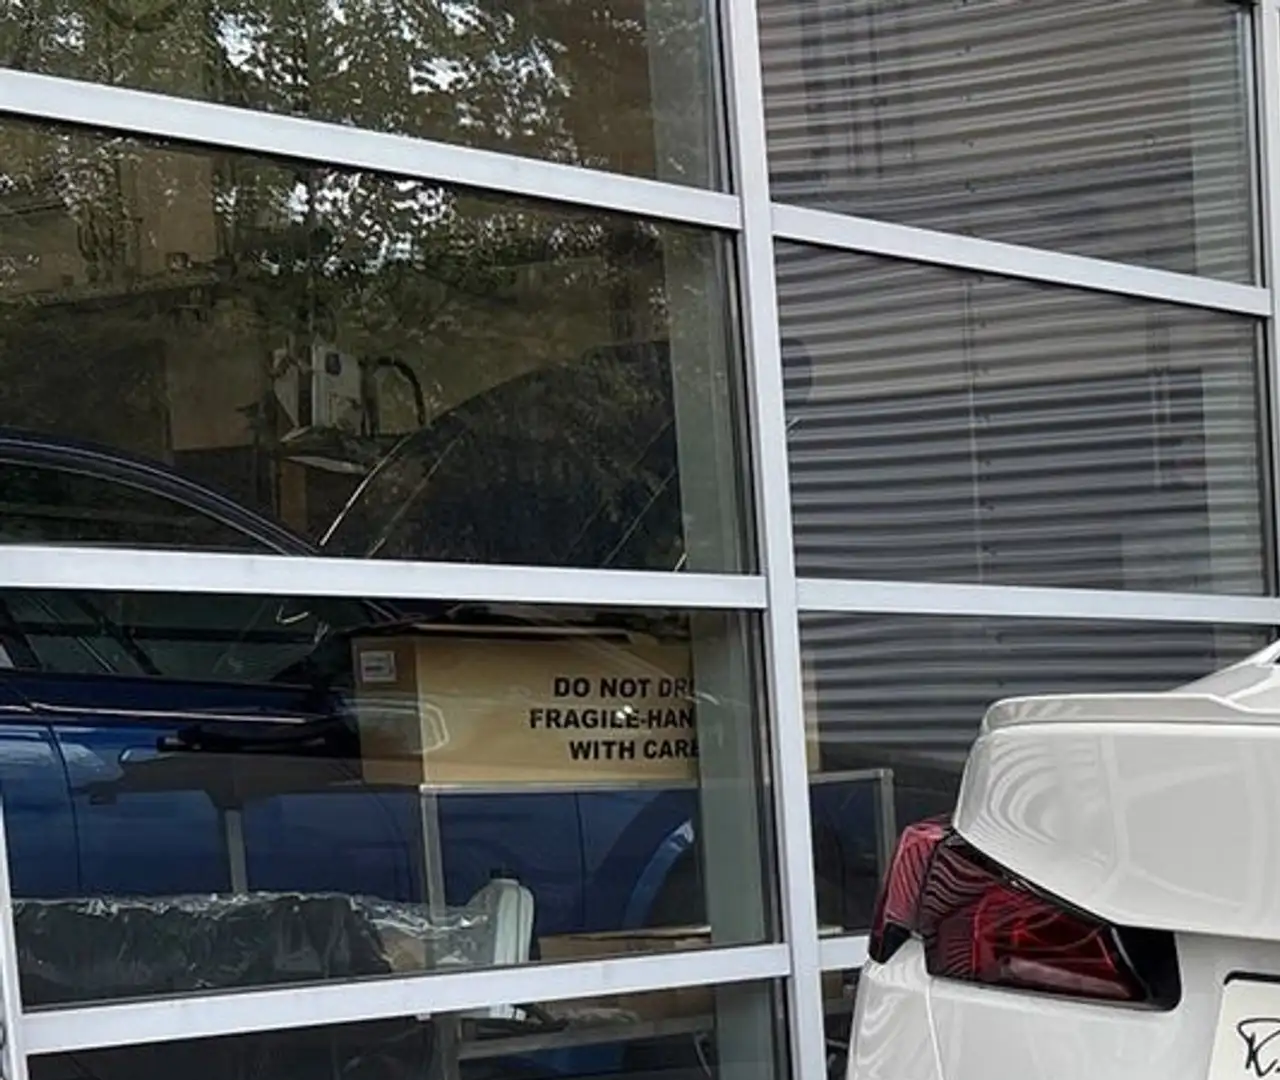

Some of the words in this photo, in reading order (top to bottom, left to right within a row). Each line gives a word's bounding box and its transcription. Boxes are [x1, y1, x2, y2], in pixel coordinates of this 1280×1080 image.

[554, 677, 591, 698] DO
[600, 677, 652, 698] NOT
[569, 740, 636, 760] WITH
